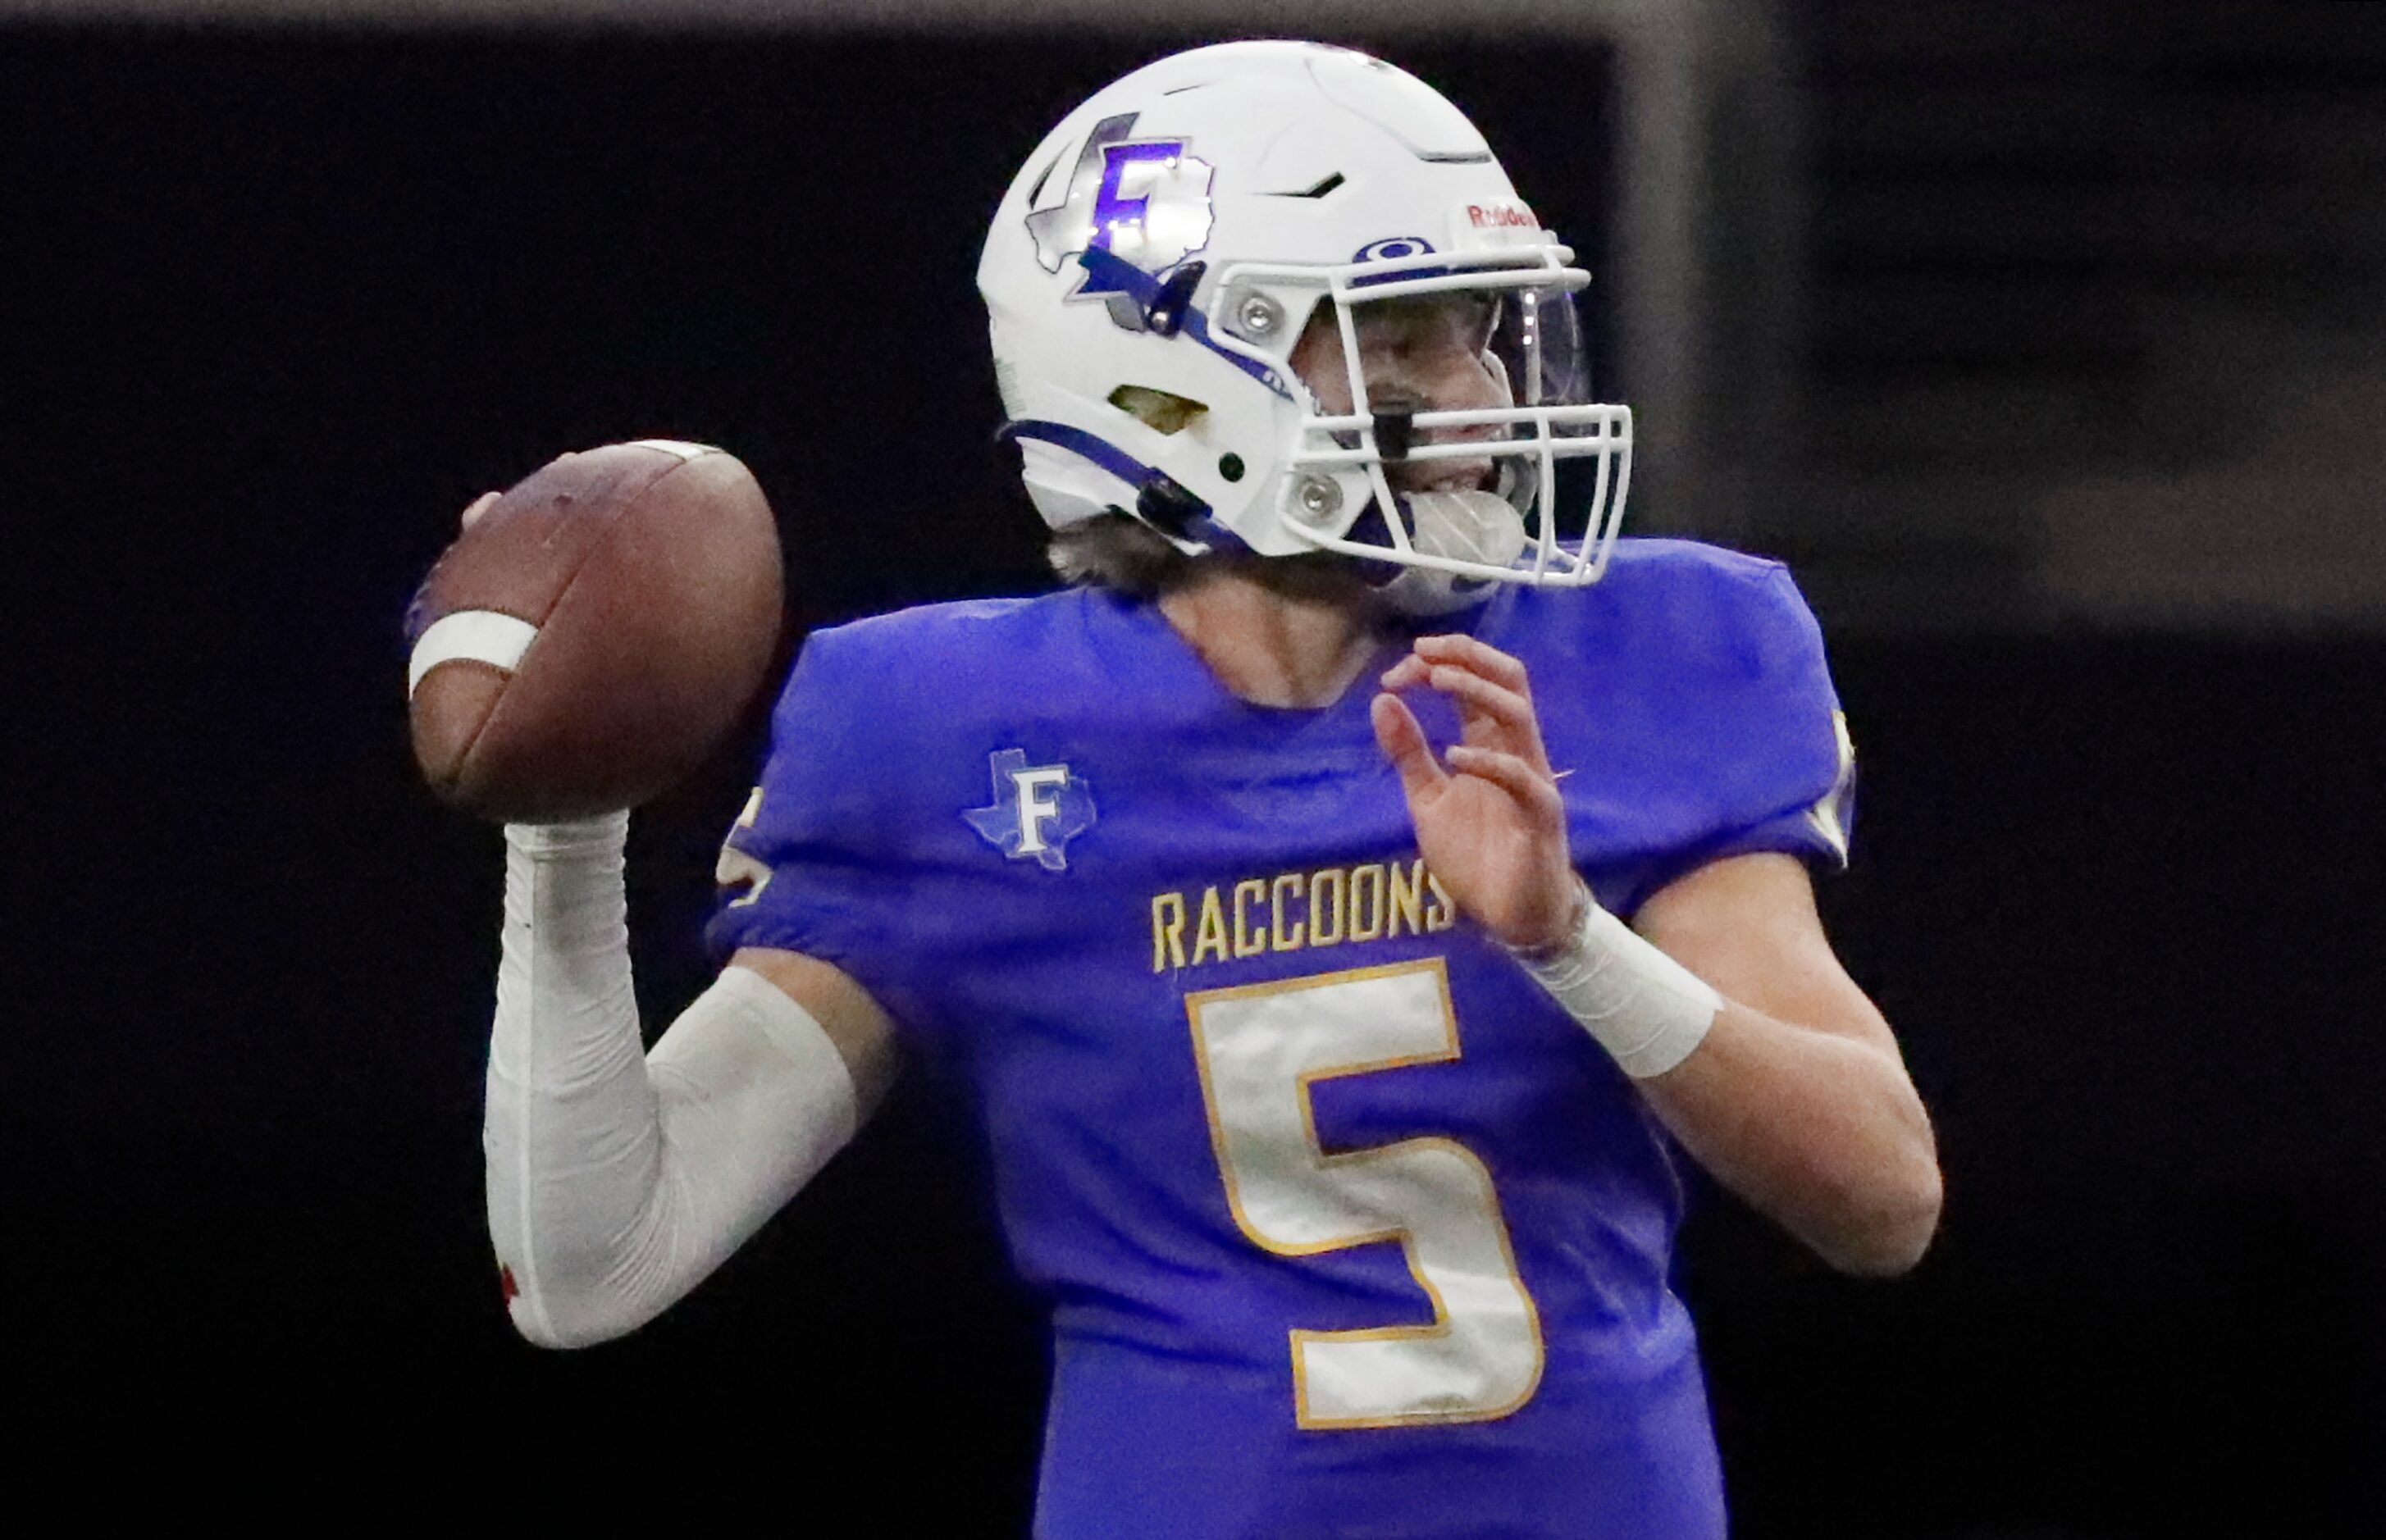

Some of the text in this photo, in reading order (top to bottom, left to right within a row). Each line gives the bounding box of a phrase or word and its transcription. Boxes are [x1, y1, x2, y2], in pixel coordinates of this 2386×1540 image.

[1070, 138, 1189, 298] F
[1008, 763, 1068, 854] F
[1151, 859, 1455, 973] RACCOONS
[1184, 956, 1544, 1429] 5
